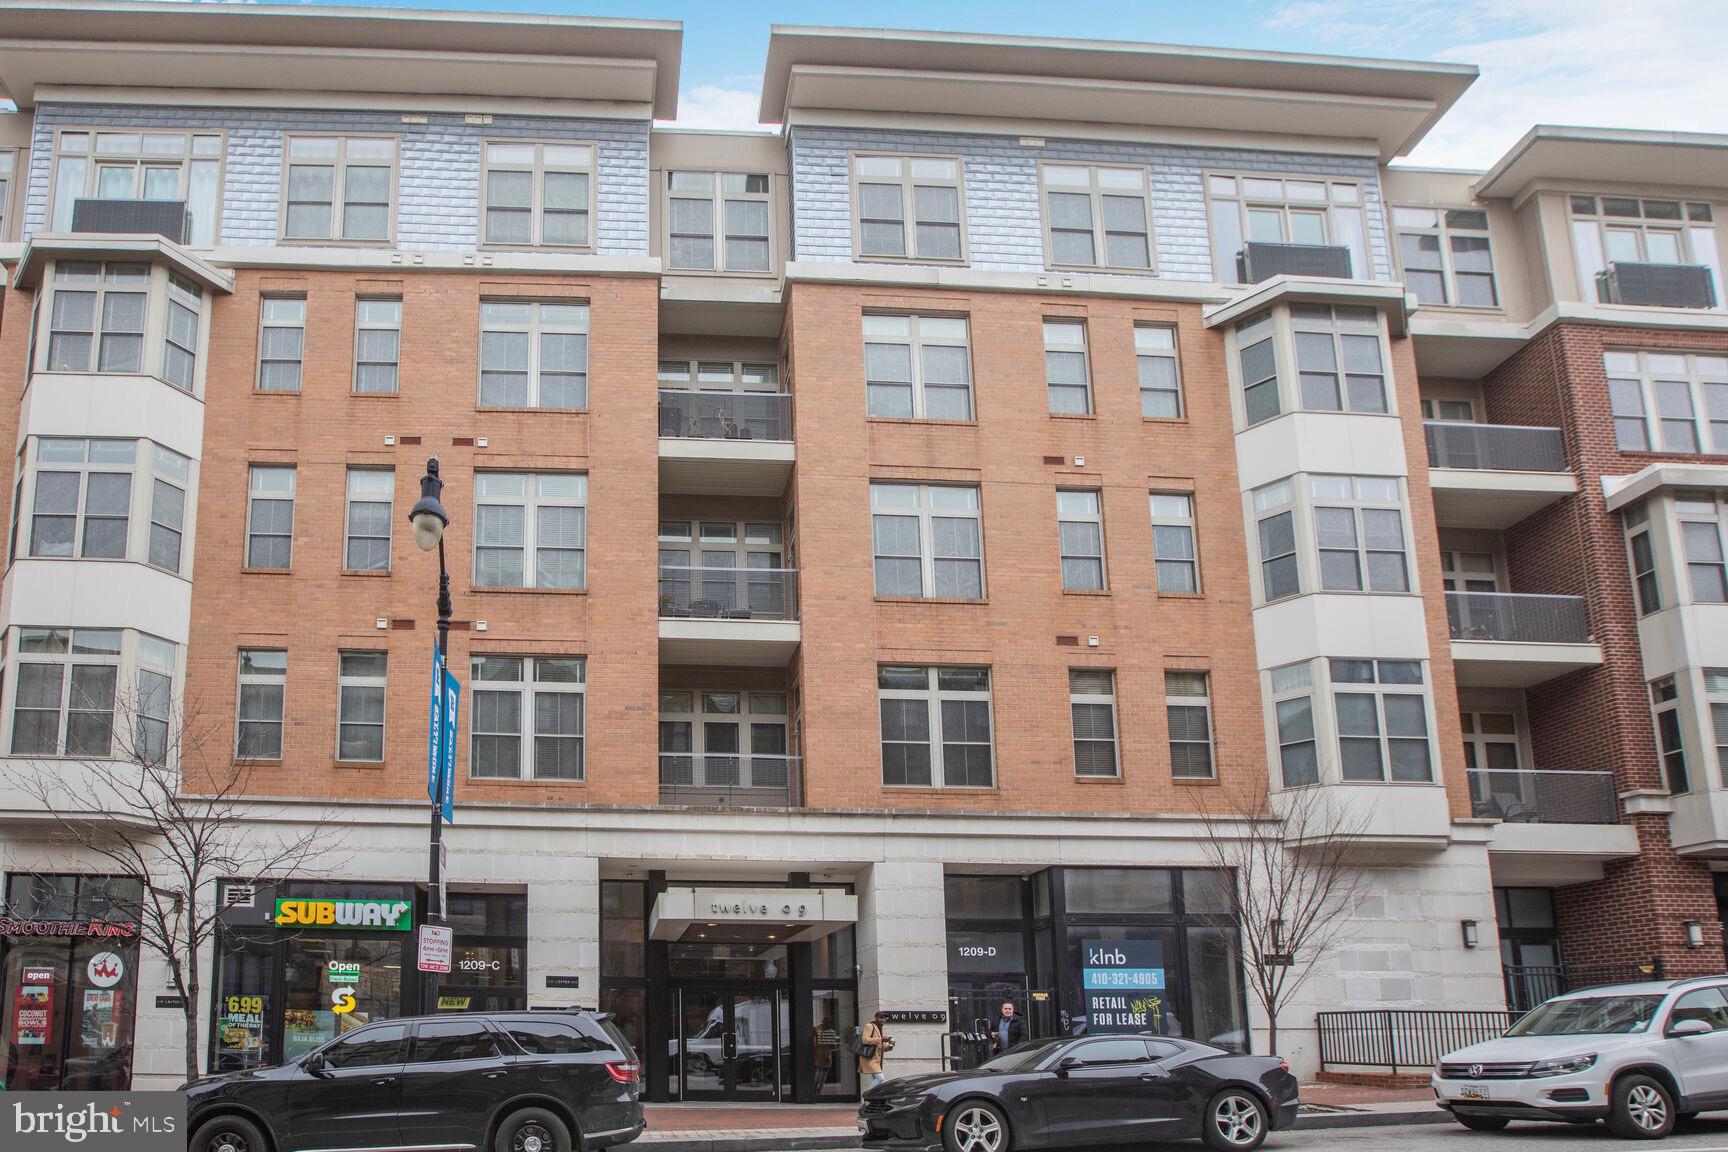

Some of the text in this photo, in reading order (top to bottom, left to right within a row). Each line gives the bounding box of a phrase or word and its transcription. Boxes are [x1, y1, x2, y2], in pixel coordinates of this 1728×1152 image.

[275, 901, 409, 926] SUBWAY
[711, 902, 768, 914] twelve
[0, 917, 135, 937] SMOOTHIE KING
[422, 938, 449, 946] STOPPING
[958, 946, 997, 957] 1209-D
[1089, 948, 1127, 965] klnb
[328, 960, 360, 973] Open
[459, 960, 500, 971] 1209-C
[27, 972, 50, 980] open
[1091, 972, 1158, 985] 410-321-4905
[225, 996, 263, 1013] $6.99
[440, 997, 467, 1007] NEW
[1092, 996, 1127, 1009] RETAIL
[19, 1009, 48, 1017] COCONUT
[227, 1013, 261, 1023] MEAL
[885, 1012, 927, 1020] welve
[1093, 1013, 1147, 1026] FOR LEASE
